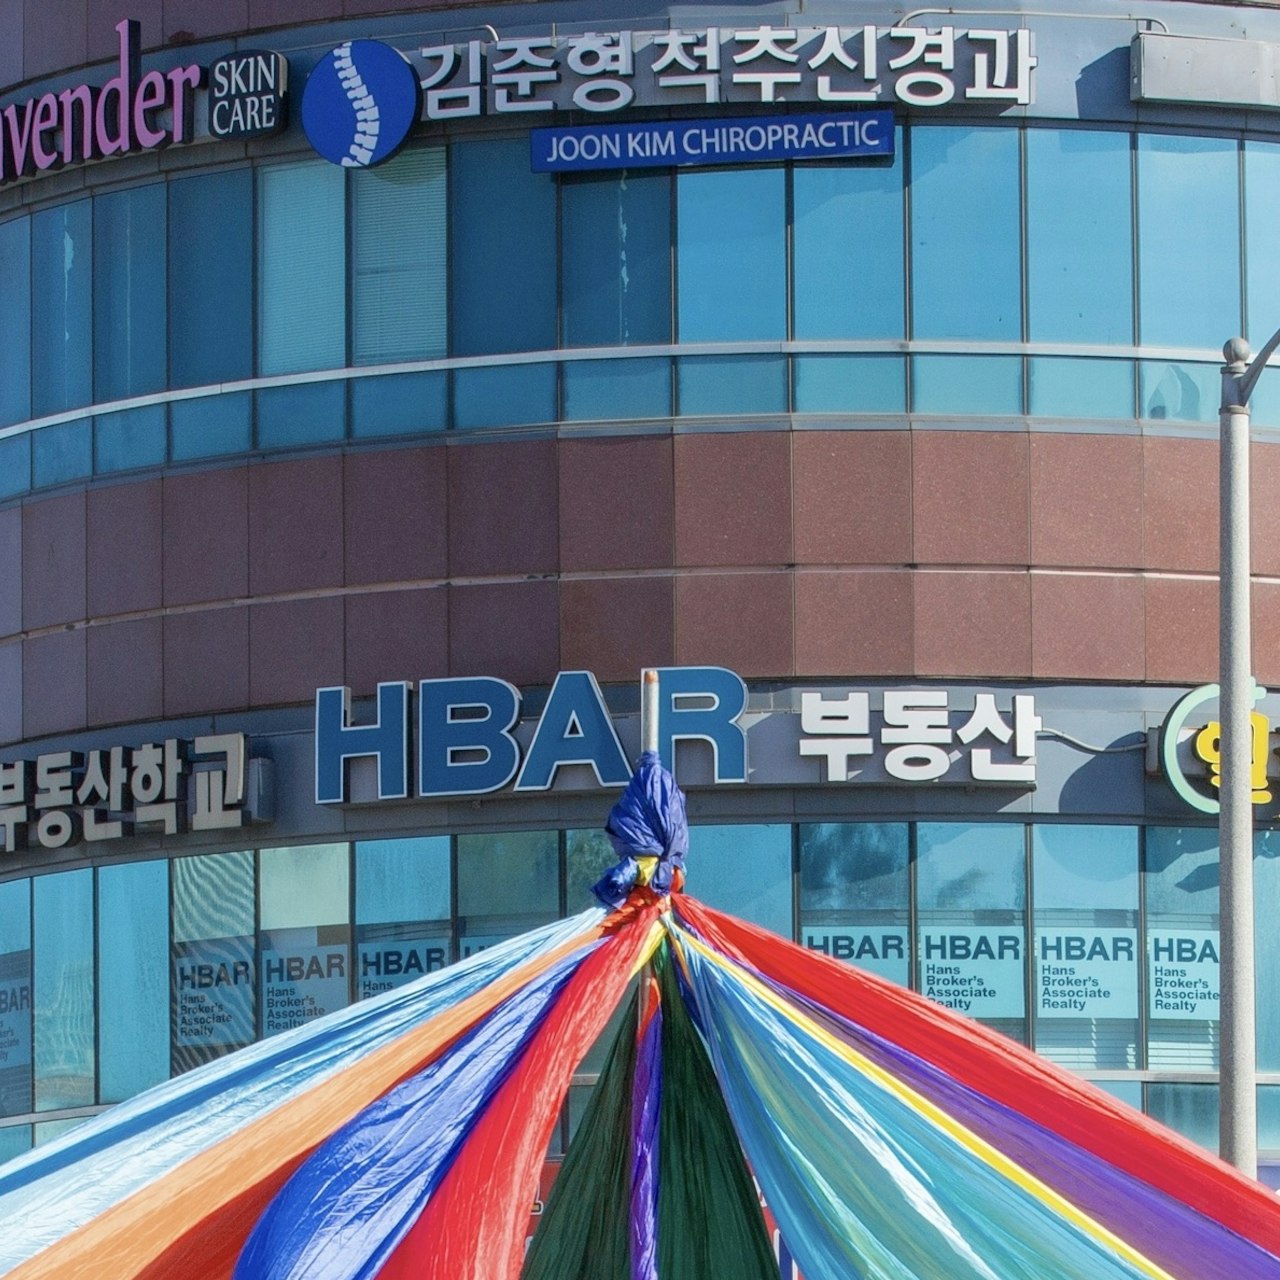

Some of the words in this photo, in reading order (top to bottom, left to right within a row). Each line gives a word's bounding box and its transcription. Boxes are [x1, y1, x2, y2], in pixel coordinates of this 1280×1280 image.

[214, 54, 275, 98] SKIN
[212, 95, 275, 135] CARE
[546, 133, 620, 163] JOON
[627, 130, 675, 157] KIM
[682, 120, 880, 155] CHIROPRACTIC
[315, 666, 750, 805] HBAR
[799, 691, 1043, 782] 부동산
[924, 935, 1020, 960] HBAR
[1040, 936, 1134, 962] HBAR
[1153, 937, 1219, 963] HBA
[266, 953, 345, 983] HBAR
[361, 947, 446, 976] HBAR
[178, 960, 249, 991] HBAR
[926, 964, 961, 975] Hans
[1041, 965, 1076, 976] Hans
[1154, 966, 1187, 977] Hans
[363, 980, 394, 991] Hans
[926, 975, 985, 986] Broker's
[1041, 976, 1100, 987] Broker's
[1154, 978, 1209, 989] Broker's
[266, 986, 296, 997] Hans
[926, 986, 997, 998] Associate
[1041, 987, 1111, 998] Associate
[1154, 989, 1220, 1000] Associate
[180, 994, 206, 1005] Hans
[266, 995, 316, 1008] Broker's
[1041, 998, 1086, 1012] Realty
[180, 1002, 223, 1015] Broker's
[266, 1006, 326, 1019] Associate
[1154, 1000, 1197, 1013] Realty
[180, 1012, 233, 1026] Associate
[180, 1026, 214, 1037] Realty
